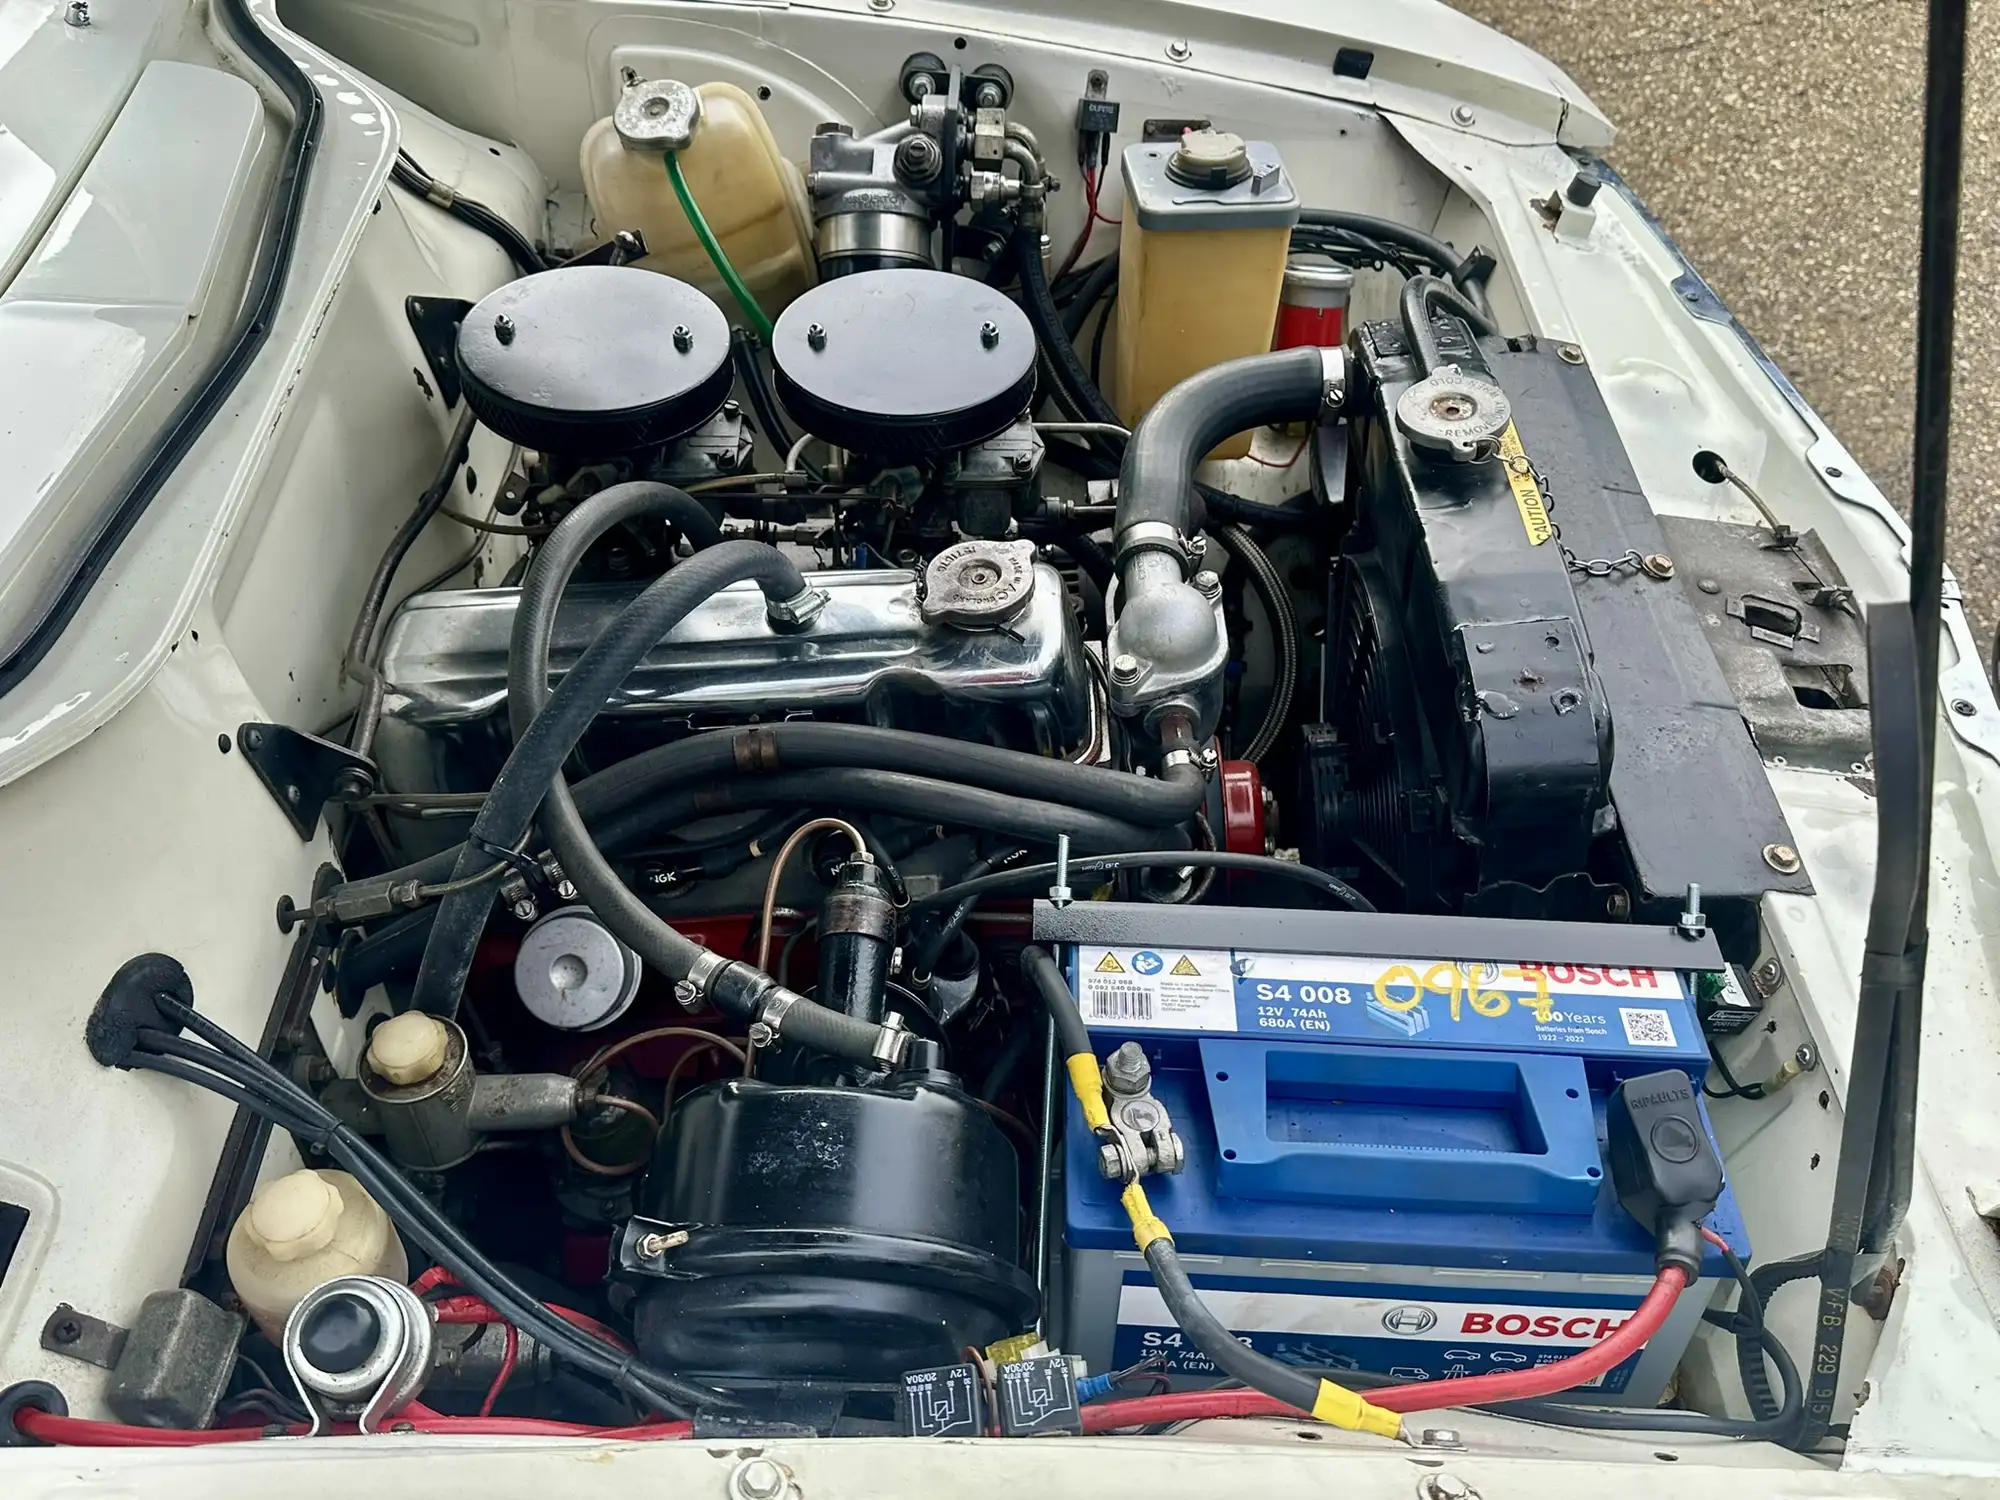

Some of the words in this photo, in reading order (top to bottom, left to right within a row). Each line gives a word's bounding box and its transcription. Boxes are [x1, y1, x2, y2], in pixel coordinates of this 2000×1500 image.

[1429, 378, 1462, 387] COLD
[1470, 380, 1500, 401] WHEN
[1444, 420, 1496, 437] REMOVE
[1520, 489, 1551, 542] CAUTION
[1257, 984, 1292, 1001] S4
[1300, 986, 1352, 1004] 008
[1258, 1006, 1283, 1016] 12V
[1291, 1008, 1327, 1018] 74Ah
[1563, 1012, 1606, 1024] Years
[1259, 1018, 1296, 1028] 680A
[1300, 1019, 1330, 1031] (EN)
[1535, 1025, 1567, 1034] Batteries
[1567, 1026, 1584, 1034] from
[1584, 1027, 1607, 1035] Bosch
[1630, 1088, 1690, 1110] RIPAULTS
[1460, 1313, 1628, 1339] BOSCH
[1142, 1331, 1183, 1347] S4
[1140, 1349, 1168, 1358] 12V
[1178, 1350, 1209, 1360] 74A
[1816, 1343, 1840, 1375] 229
[1003, 1361, 1035, 1374] 20/30A
[1049, 1358, 1066, 1369] 12V
[1183, 1361, 1215, 1371] (EN)
[905, 1371, 937, 1384] 20/30A
[950, 1368, 968, 1379] 12V
